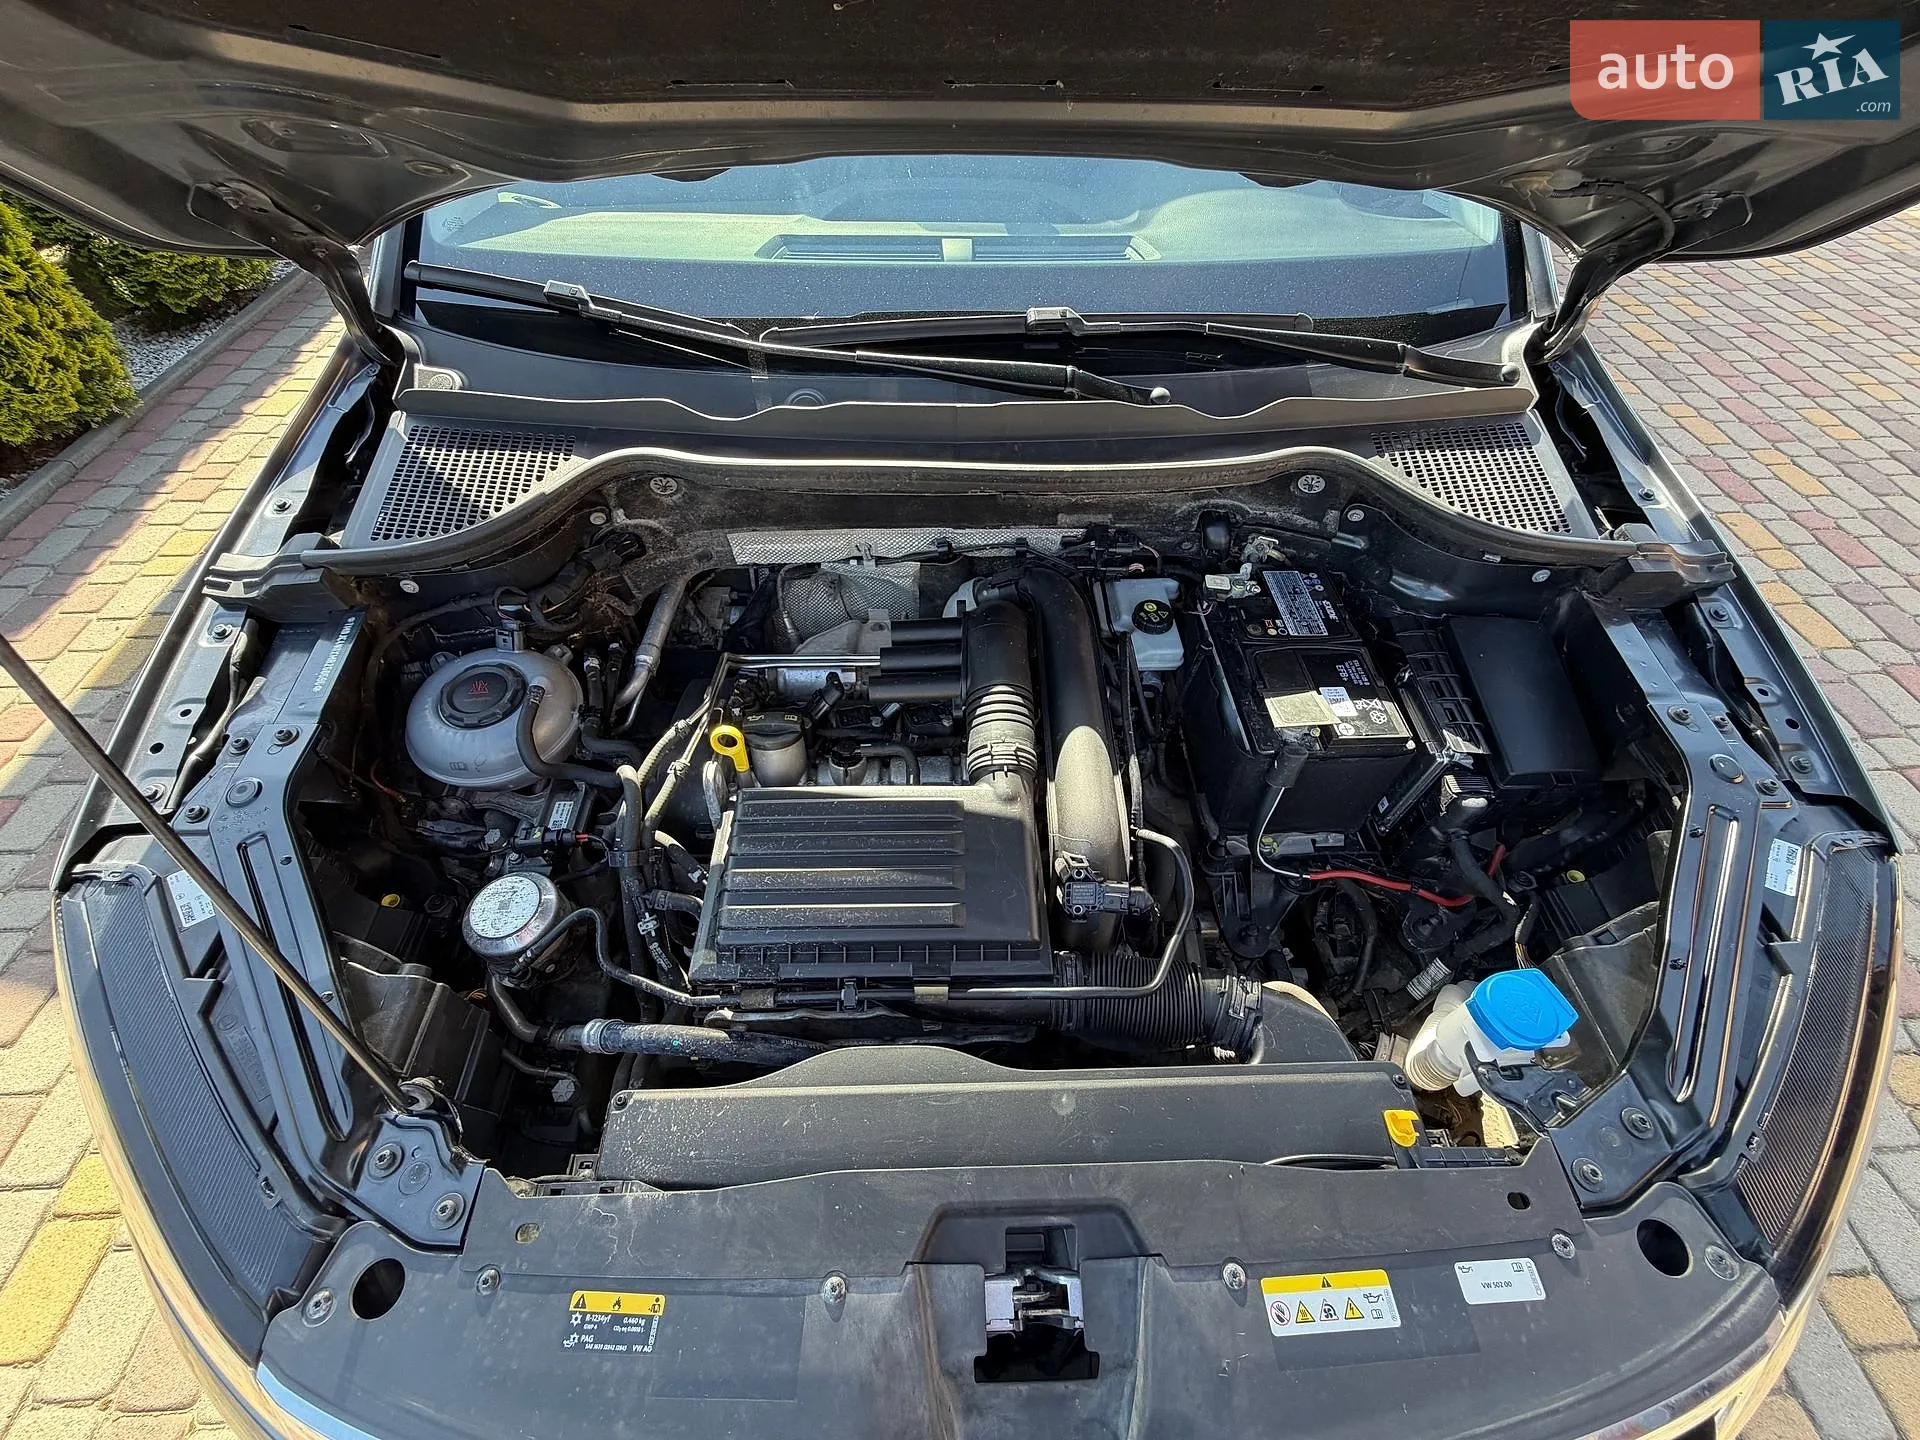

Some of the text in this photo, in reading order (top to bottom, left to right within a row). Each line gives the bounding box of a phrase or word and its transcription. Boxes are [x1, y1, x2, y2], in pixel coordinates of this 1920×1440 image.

[1480, 1280, 1512, 1289] VW 502 00
[585, 1313, 612, 1325] R-1234yf
[580, 1334, 595, 1343] PAG
[632, 1344, 643, 1352] VW
